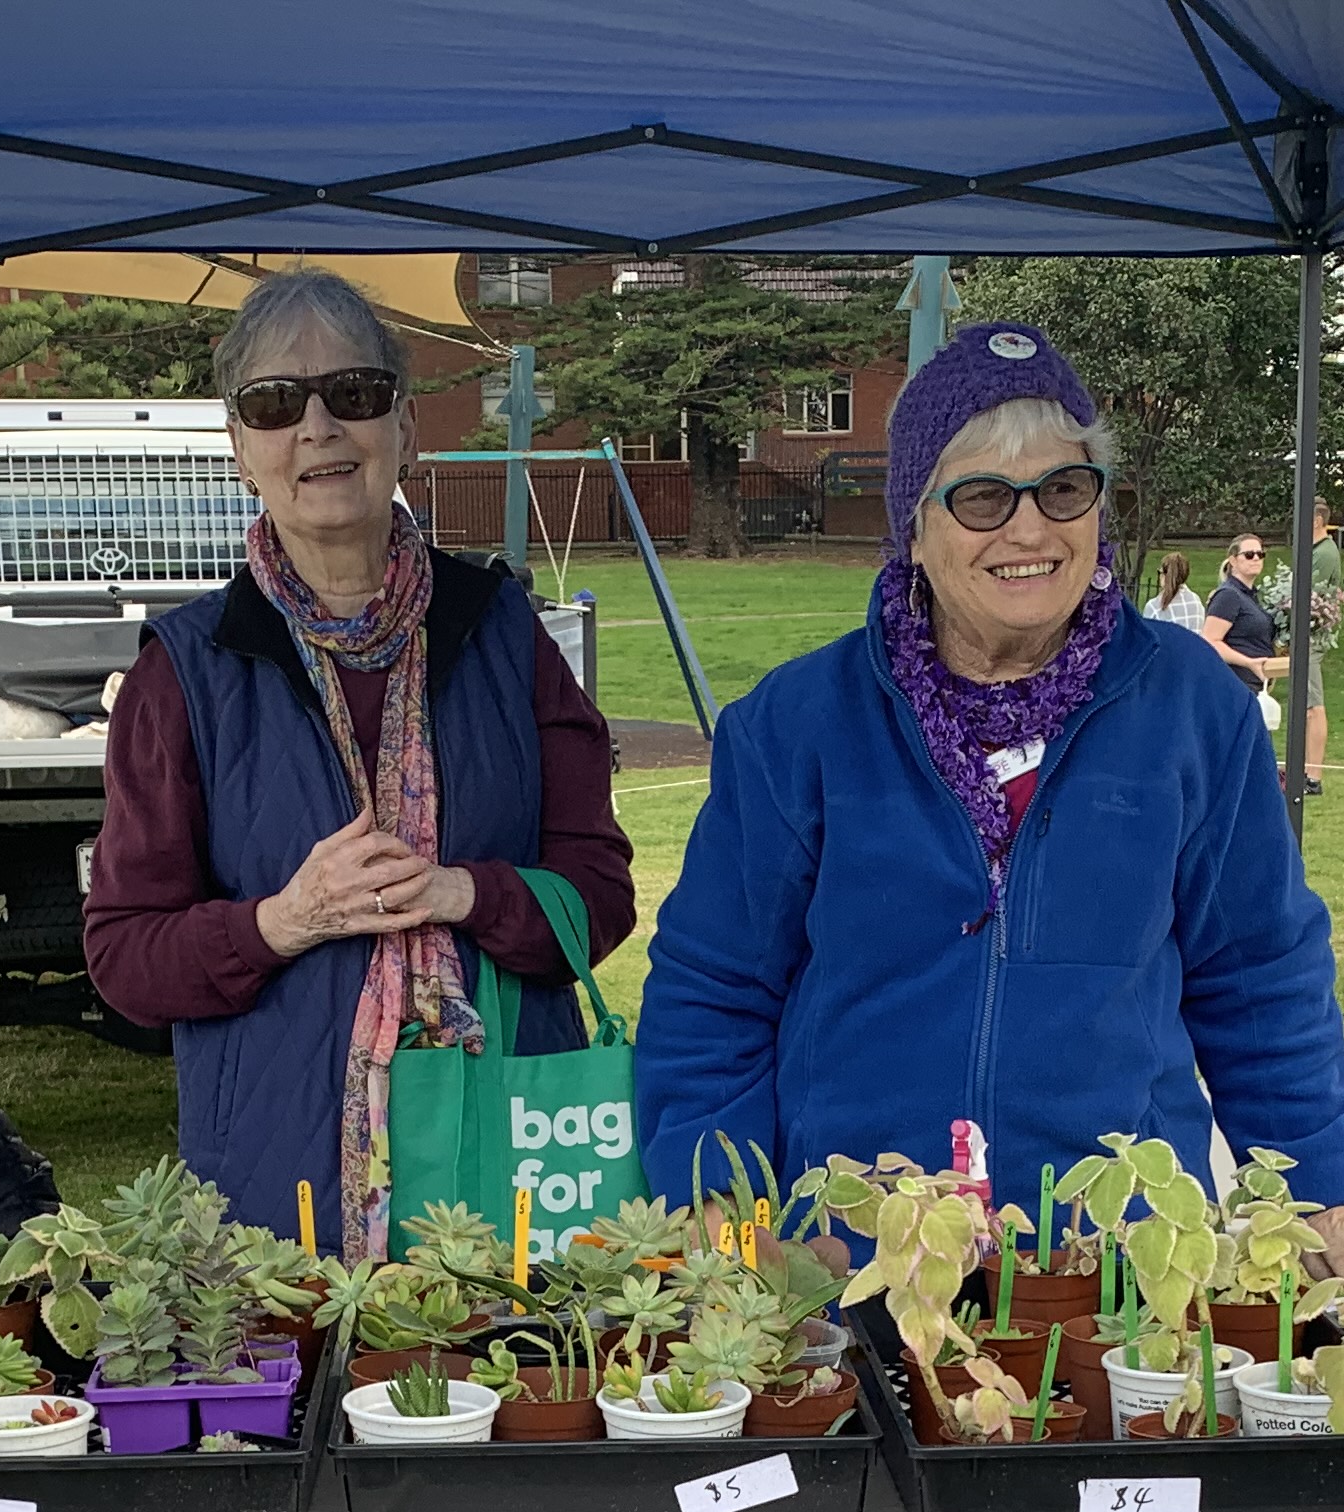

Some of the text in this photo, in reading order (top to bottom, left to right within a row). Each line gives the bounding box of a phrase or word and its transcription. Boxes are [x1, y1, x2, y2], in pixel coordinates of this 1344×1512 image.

[510, 1097, 633, 1159] bag
[512, 1158, 602, 1213] for
[1256, 1418, 1296, 1431] Potted
